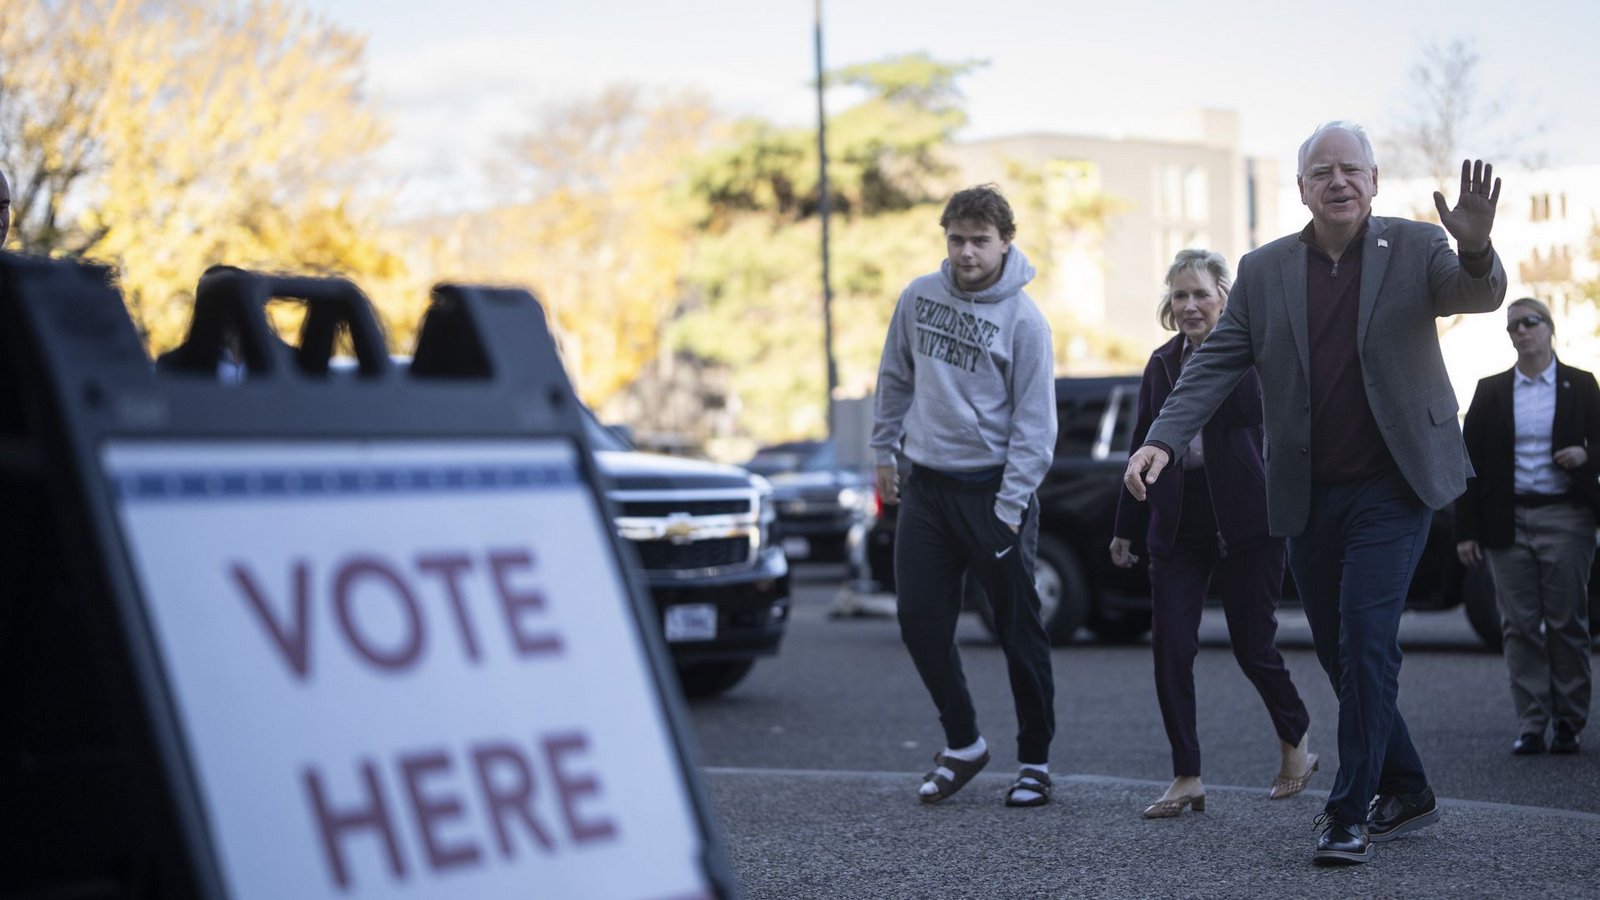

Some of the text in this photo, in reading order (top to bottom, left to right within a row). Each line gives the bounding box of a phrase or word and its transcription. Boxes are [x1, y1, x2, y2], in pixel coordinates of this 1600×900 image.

[916, 327, 982, 373] NIVERSITY
[227, 547, 567, 683] VOTE
[302, 731, 620, 892] HERE
